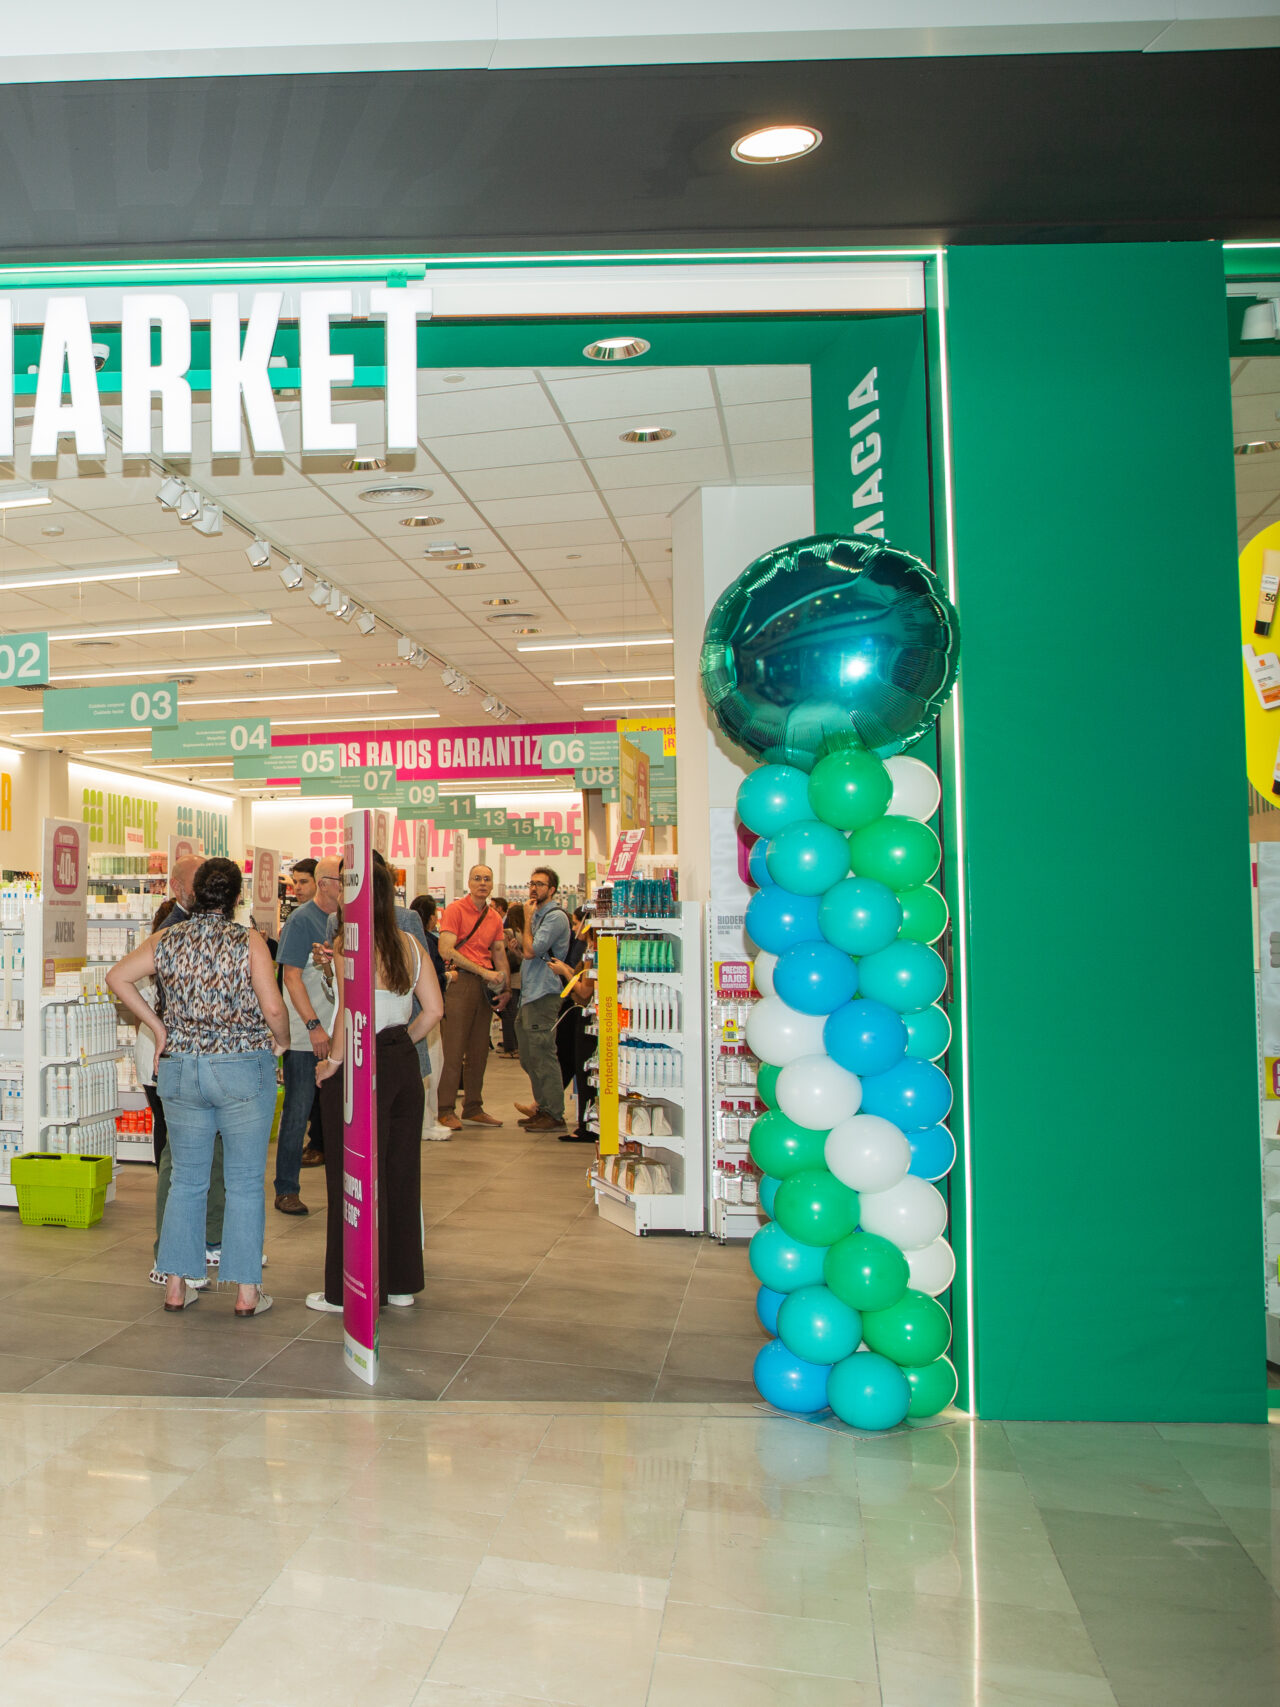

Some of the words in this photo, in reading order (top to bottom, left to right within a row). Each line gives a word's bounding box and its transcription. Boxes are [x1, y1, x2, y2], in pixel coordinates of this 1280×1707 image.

[130, 690, 173, 722] 03
[230, 725, 267, 751] 04
[301, 750, 336, 773] 05
[548, 739, 586, 765] 06
[363, 770, 394, 791] 07
[581, 767, 615, 785] 08
[408, 785, 436, 804] 09
[449, 798, 471, 816] 11
[107, 792, 159, 849] HIGIENE
[483, 811, 506, 826] 13
[512, 821, 533, 834] 15
[534, 828, 552, 842] 17
[553, 836, 571, 848] 19
[721, 965, 748, 974] PRECIOS
[722, 974, 747, 983] BAJOS
[605, 996, 613, 1033] solares
[605, 1037, 614, 1095] Protectores
